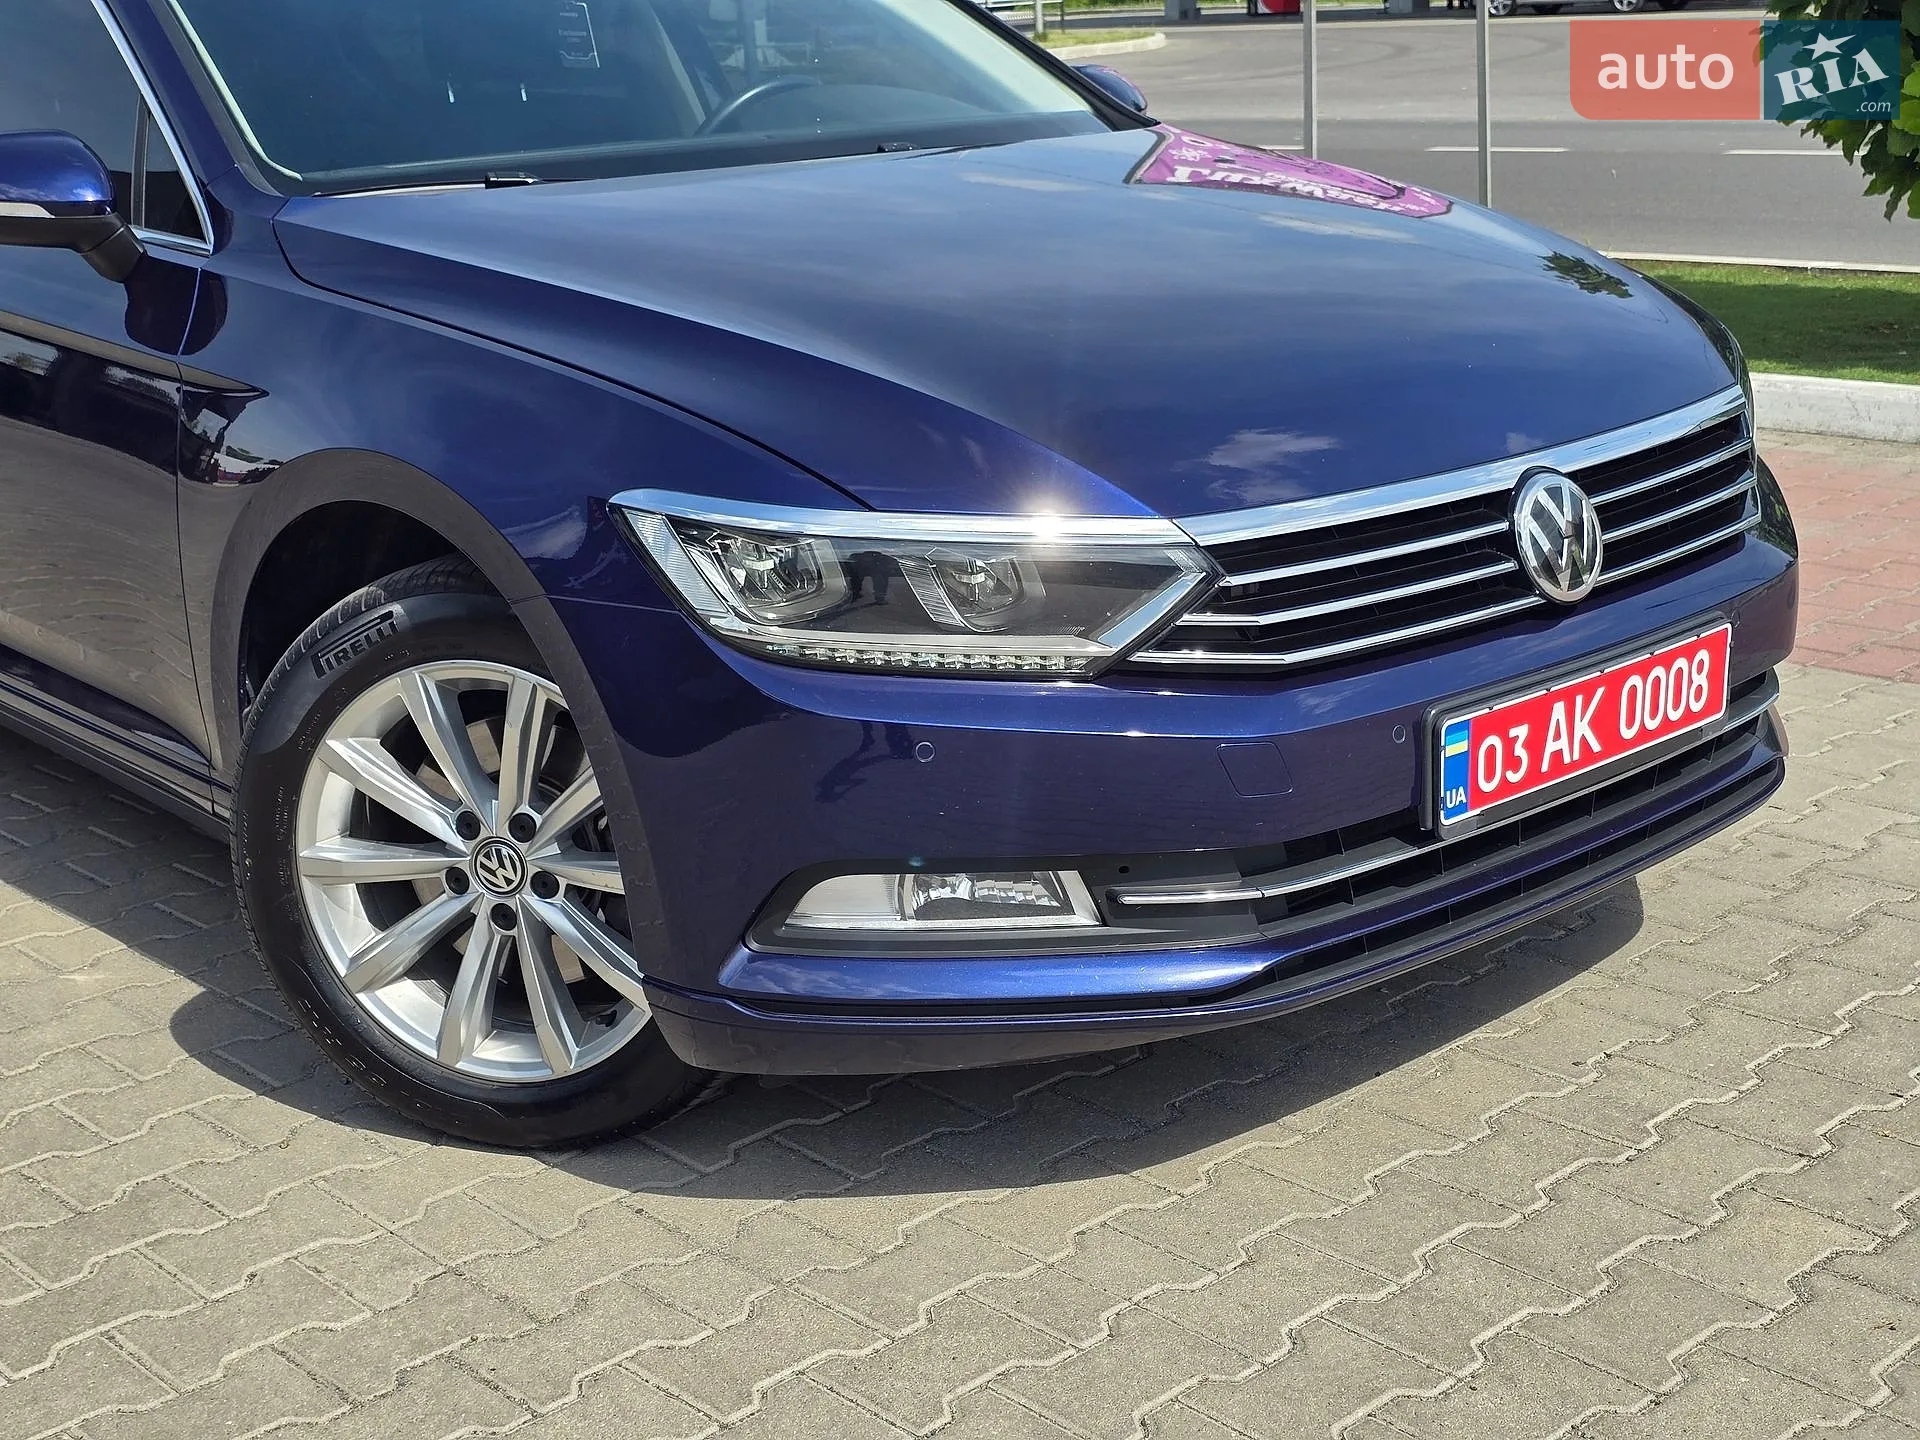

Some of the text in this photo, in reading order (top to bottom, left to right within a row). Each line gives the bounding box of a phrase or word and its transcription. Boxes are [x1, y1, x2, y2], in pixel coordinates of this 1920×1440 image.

[310, 609, 401, 679] PIRELLI
[1476, 648, 1711, 794] 03 AK 0008
[1446, 786, 1467, 809] UA
